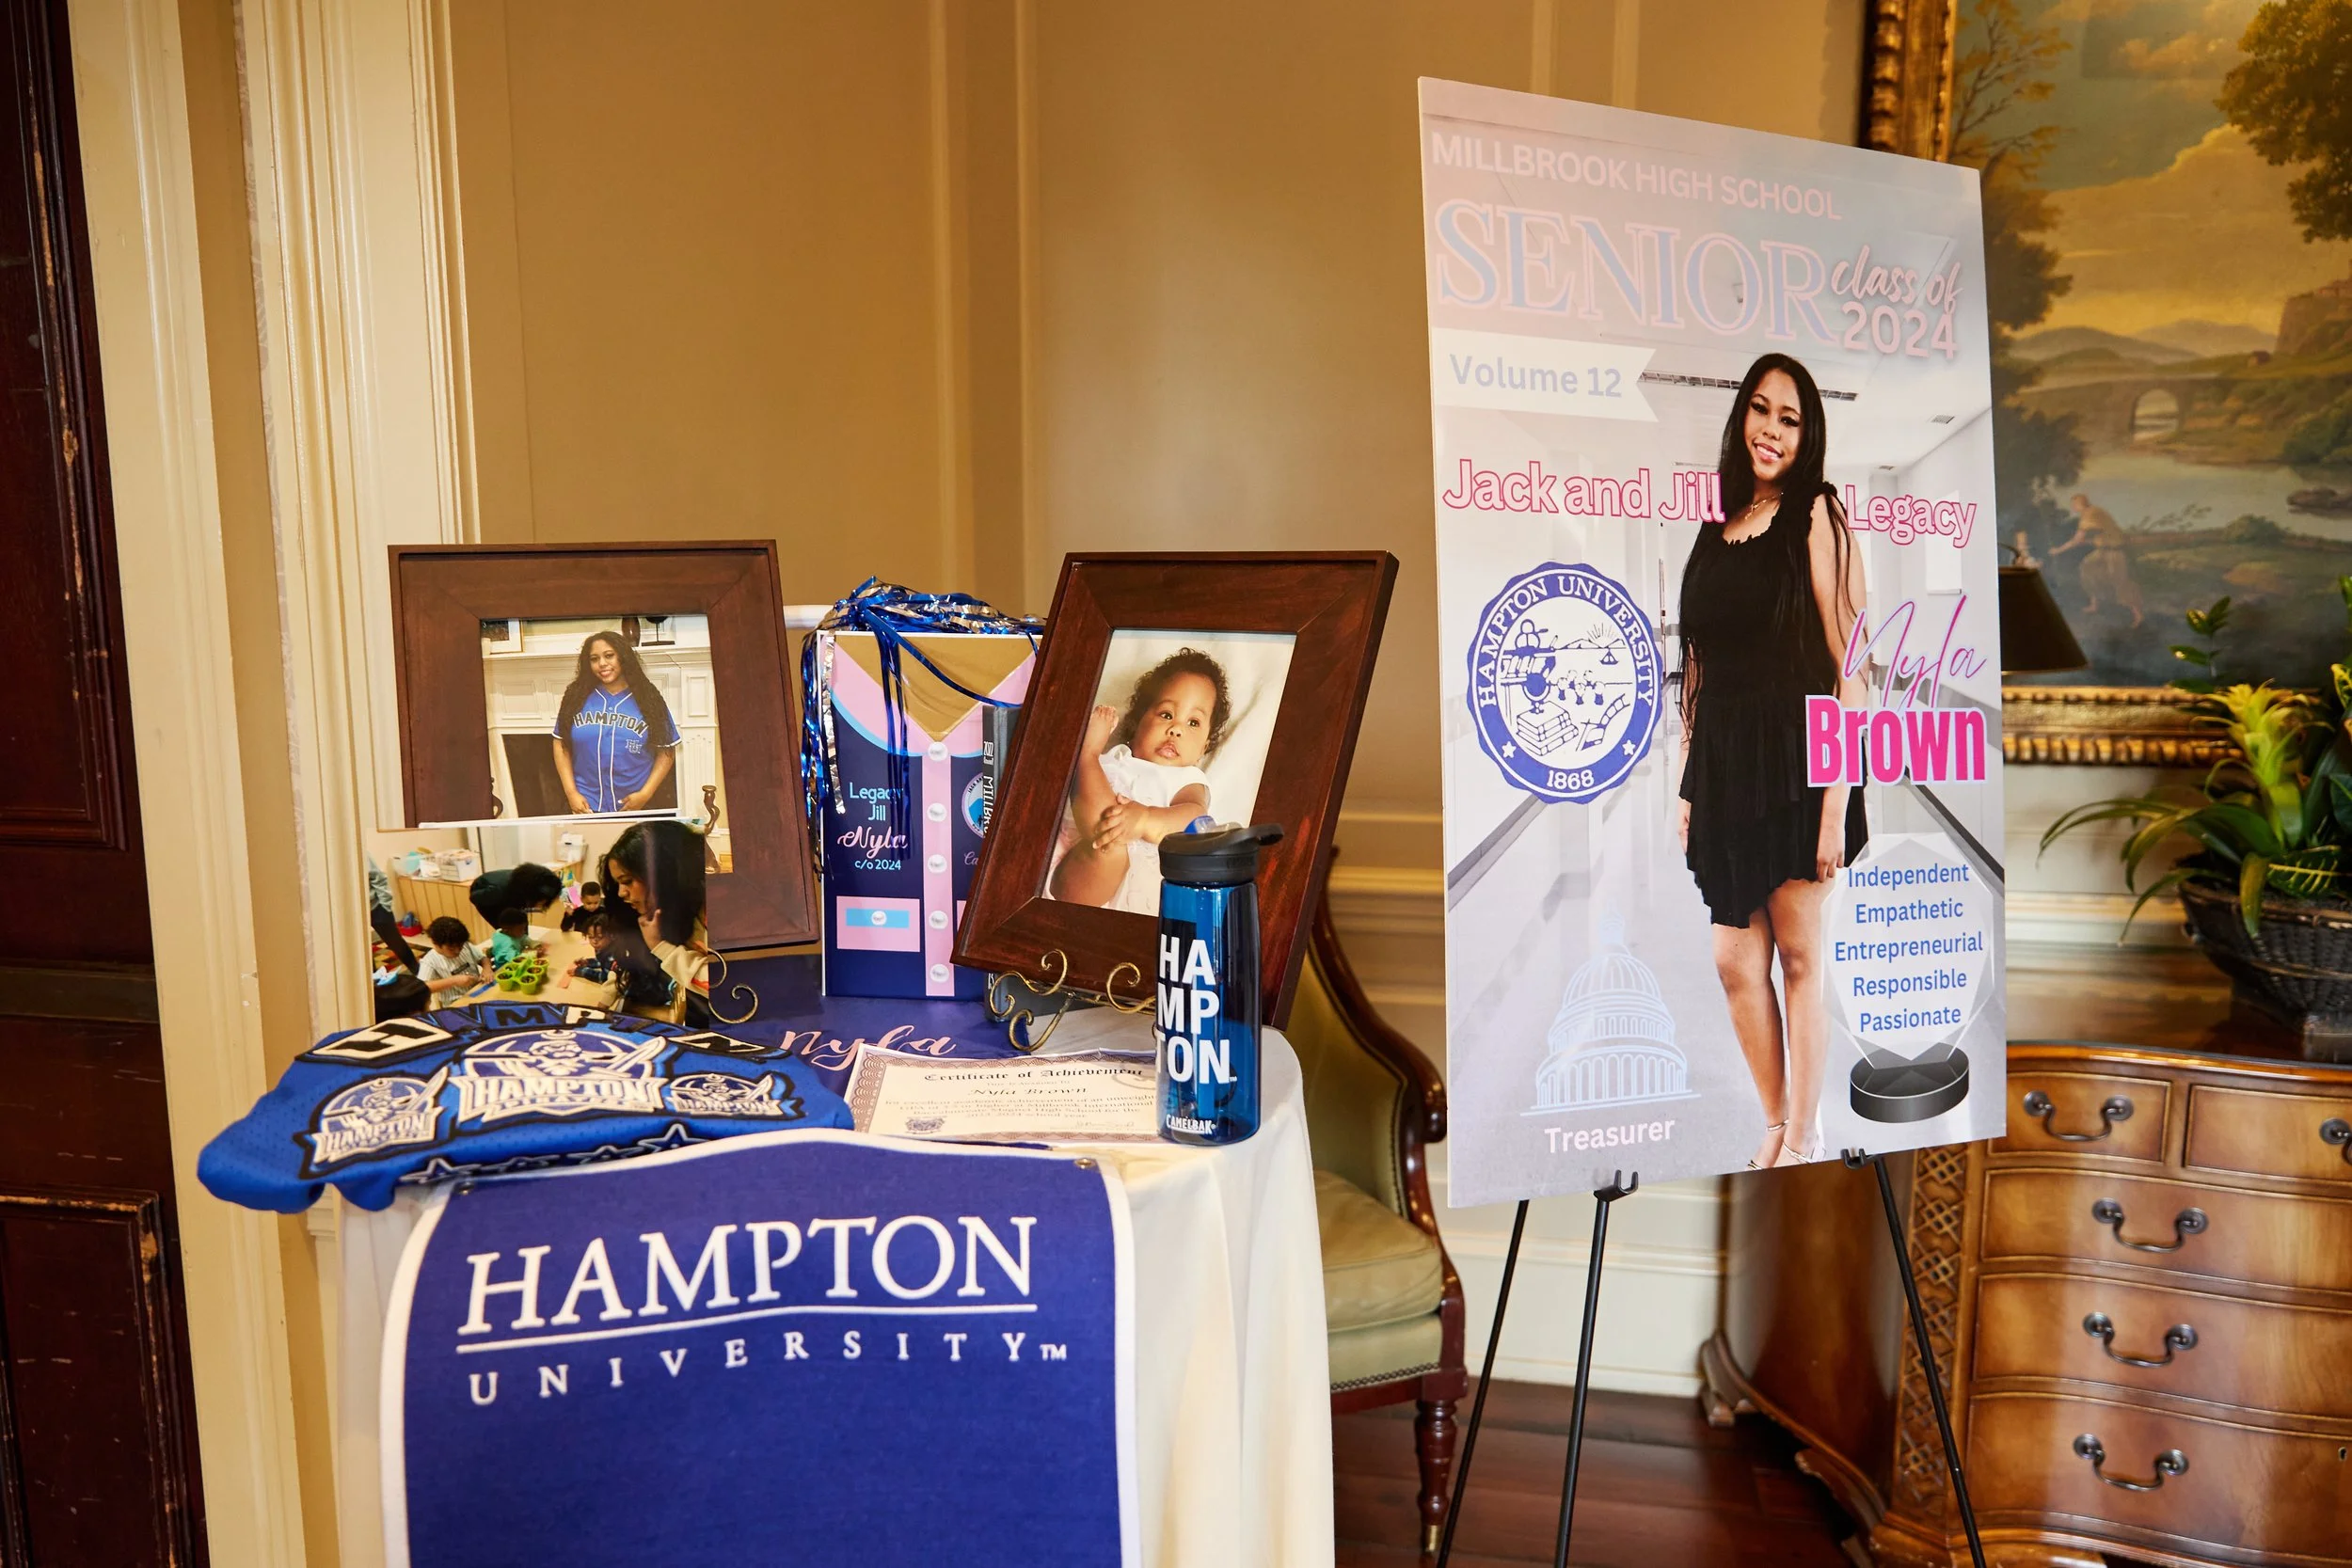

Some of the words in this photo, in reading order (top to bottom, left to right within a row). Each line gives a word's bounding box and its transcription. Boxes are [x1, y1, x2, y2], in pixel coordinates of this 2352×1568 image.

[1431, 131, 1629, 190] MILLBROOK
[1635, 163, 1712, 202] HIGH
[1720, 175, 1842, 221] SCHOOL
[1435, 198, 1839, 346] SENIOR
[1831, 244, 1919, 304] class
[1926, 261, 1964, 315] of
[1841, 300, 1961, 359] 2024
[1449, 354, 1579, 394] Volume
[1587, 367, 1622, 398] 12
[1443, 459, 1559, 514] Jack
[1564, 467, 1651, 518] and
[1659, 469, 1726, 524] Jill
[1846, 484, 1978, 547] Legacy
[1478, 578, 1548, 707] HAMPTON
[1557, 575, 1654, 706] UNIVERSITY
[1844, 594, 1988, 711] Nyla
[573, 710, 649, 737] HAMPTON
[1806, 696, 1986, 786] Brown
[1546, 768, 1595, 790] 1868
[867, 804, 886, 821] Jill
[983, 775, 995, 835] MILLBR
[837, 826, 909, 859] Nyla
[854, 860, 874, 870] c/o
[875, 859, 902, 870] 2024
[1848, 863, 1970, 891] Independent
[1855, 897, 1964, 927] Empathetic
[1159, 933, 1216, 986] HA
[1835, 931, 1984, 963] Entrepreneurial
[1853, 969, 1967, 1000] Responsible
[1157, 983, 1220, 1035] MP
[1860, 1006, 1963, 1033] Passionate
[472, 1076, 651, 1108] HAMPTON
[924, 1071, 1009, 1082] Certificate
[1041, 1068, 1143, 1078] Achievement
[326, 1114, 427, 1153] HAMPTON
[1167, 1114, 1213, 1134] CAMELBAK
[1544, 1118, 1676, 1154] Treasurer
[457, 1214, 1038, 1336] HAMPTON
[469, 1329, 1027, 1405] UNIVERSITY
